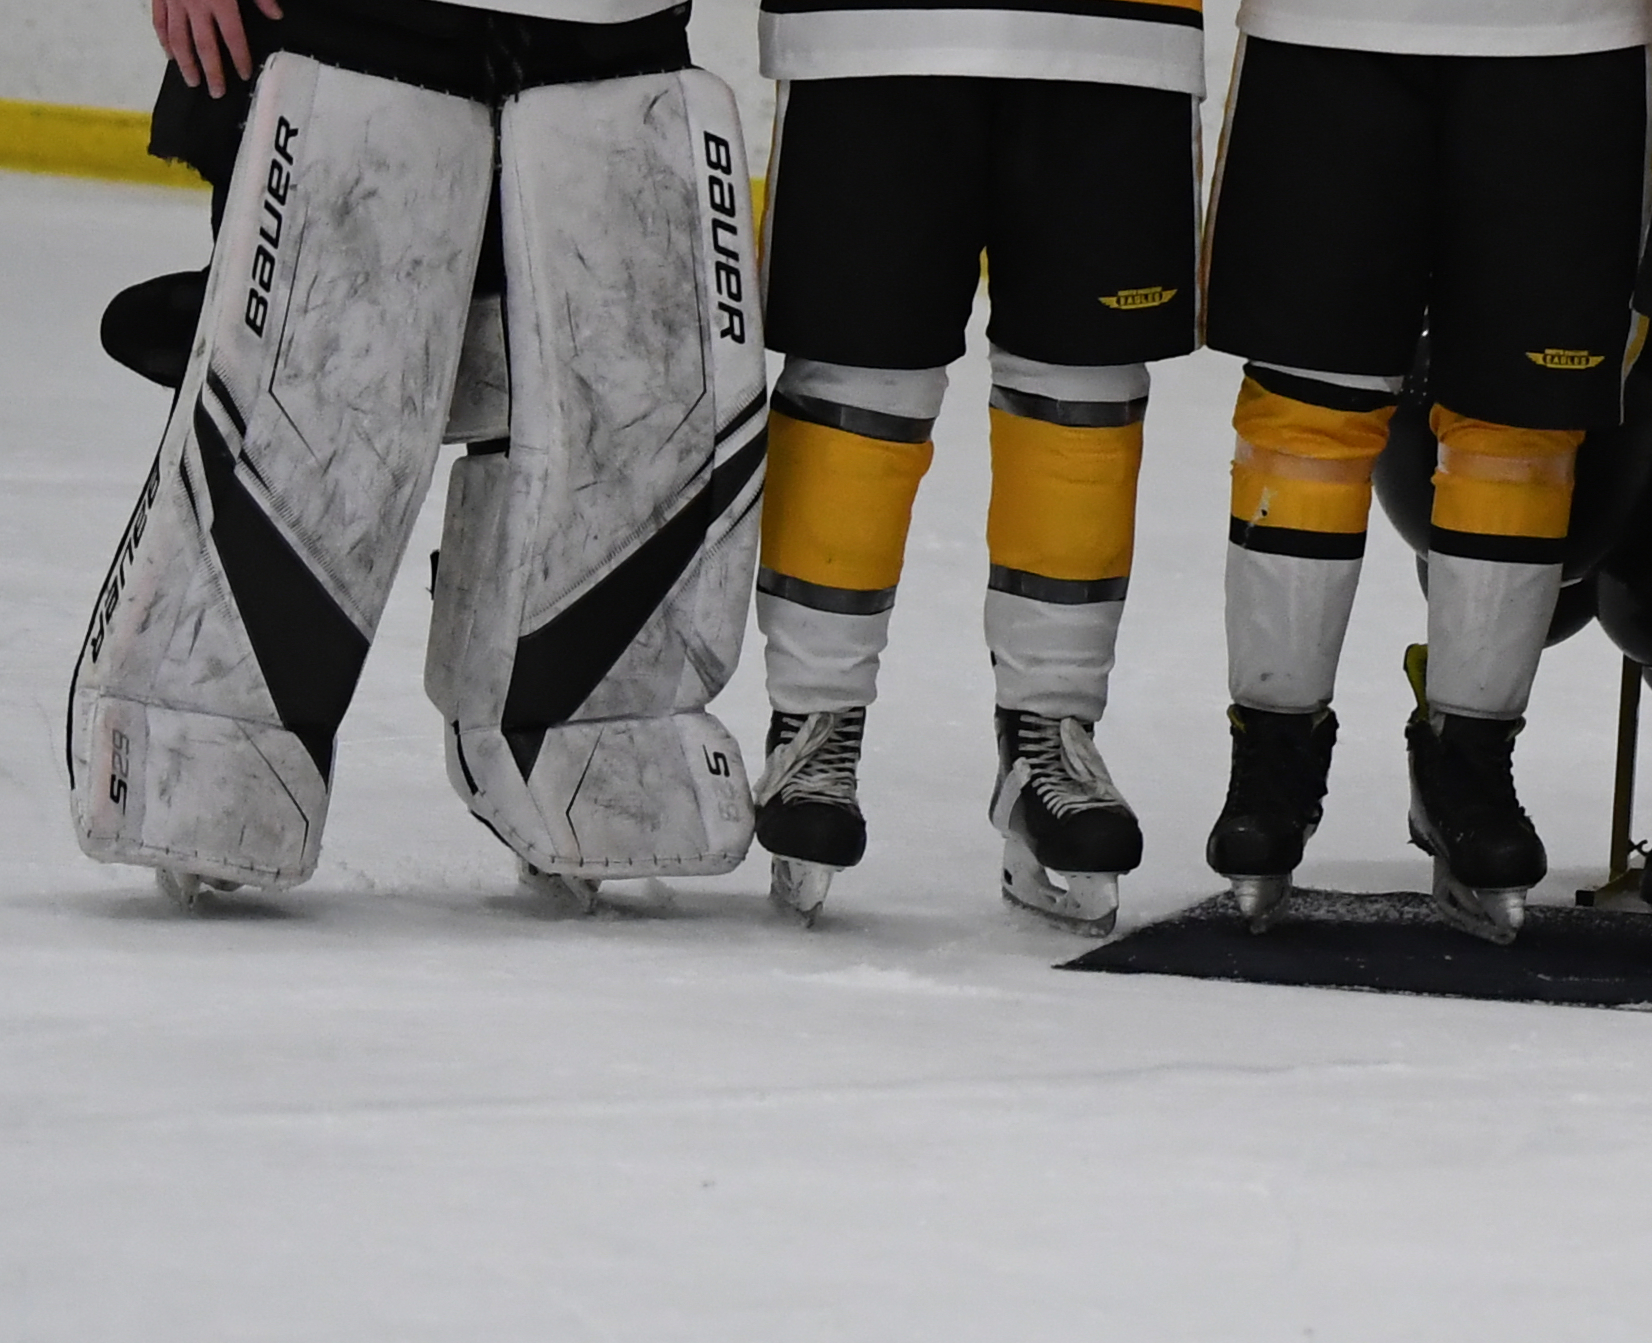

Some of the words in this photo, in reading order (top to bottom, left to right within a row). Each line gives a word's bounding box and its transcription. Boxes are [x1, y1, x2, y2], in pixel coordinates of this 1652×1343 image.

[245, 116, 299, 338] BAUER
[702, 131, 746, 346] BAUER
[109, 728, 130, 816] S29
